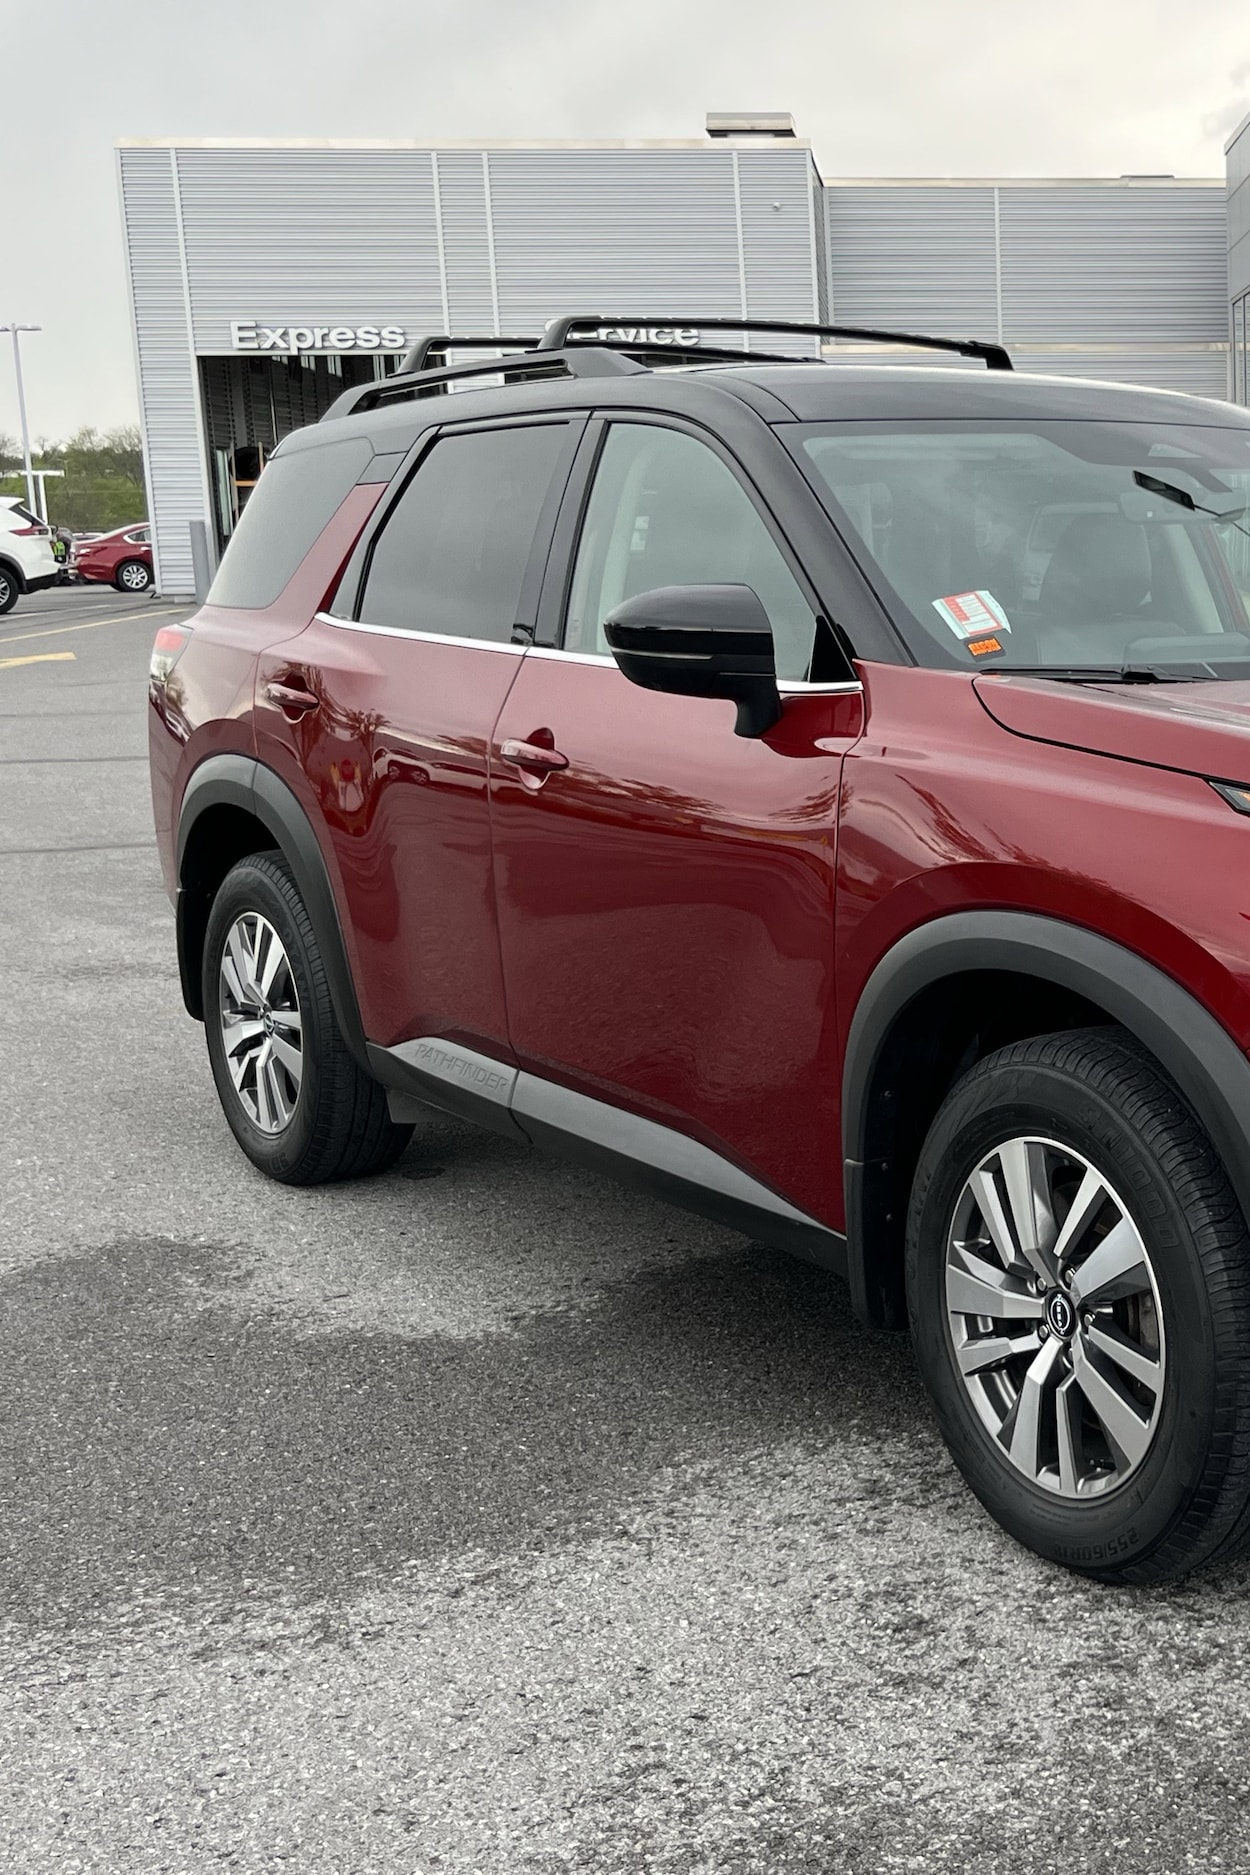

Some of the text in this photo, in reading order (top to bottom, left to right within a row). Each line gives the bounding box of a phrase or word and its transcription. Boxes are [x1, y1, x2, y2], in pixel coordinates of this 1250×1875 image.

[230, 317, 700, 355] Express rvice
[414, 1043, 509, 1090] PATHFINDER
